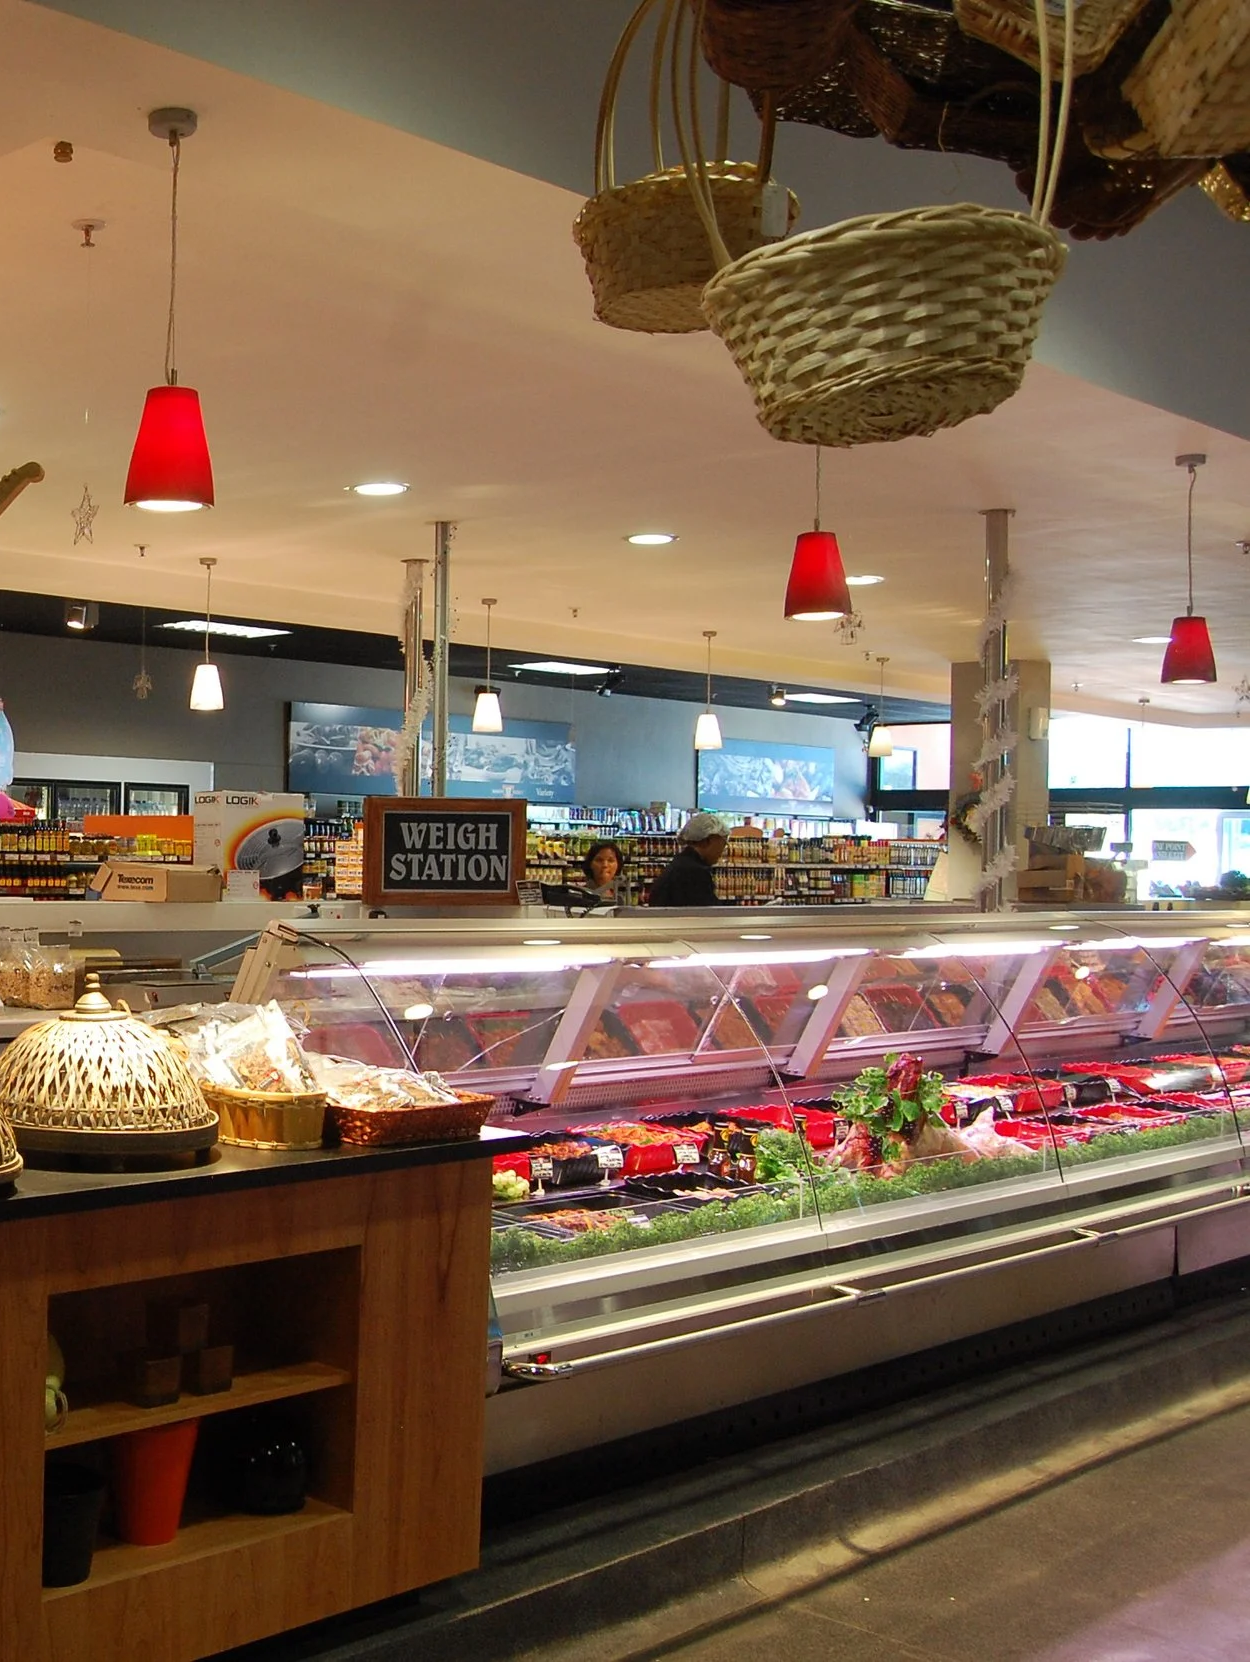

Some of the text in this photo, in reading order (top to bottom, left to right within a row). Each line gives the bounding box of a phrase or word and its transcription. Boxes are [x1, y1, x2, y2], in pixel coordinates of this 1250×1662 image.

[194, 796, 220, 804] LOGIK
[225, 795, 259, 806] LOGIK
[400, 822, 498, 850] WEIGH
[389, 853, 508, 881] STATION
